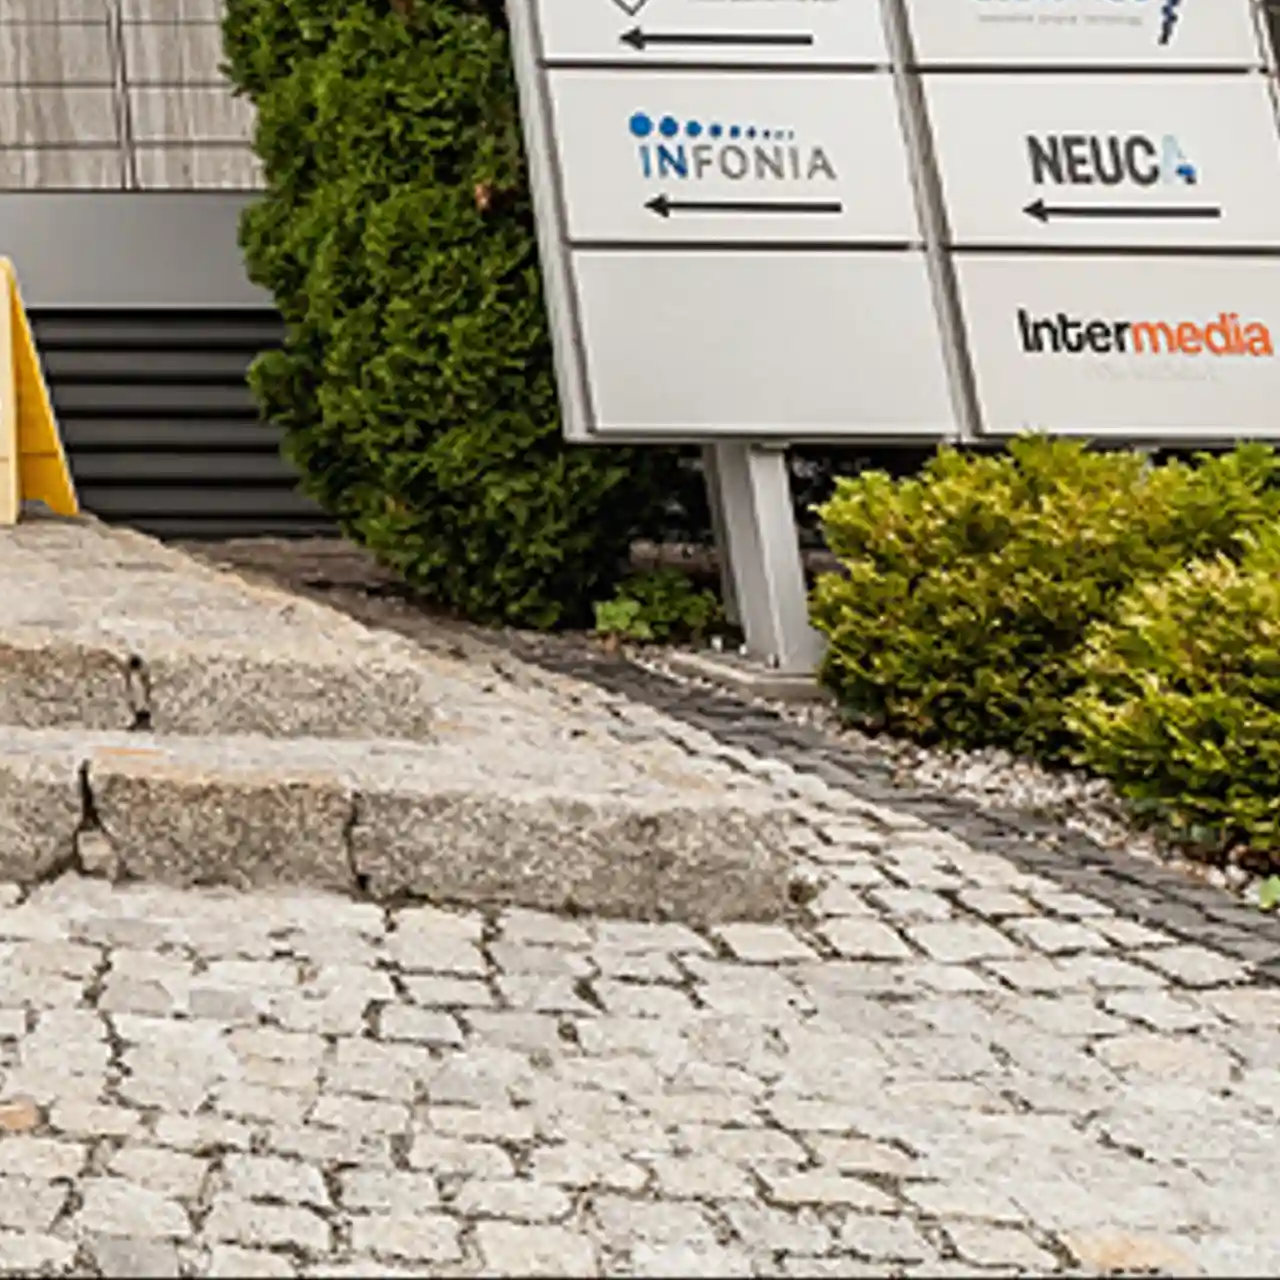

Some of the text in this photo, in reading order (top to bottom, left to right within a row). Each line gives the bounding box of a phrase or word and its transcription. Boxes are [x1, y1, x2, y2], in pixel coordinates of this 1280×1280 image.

[639, 144, 837, 180] INFONIA
[1026, 135, 1197, 186] NEUCA
[1017, 308, 1274, 357] Intermedia
